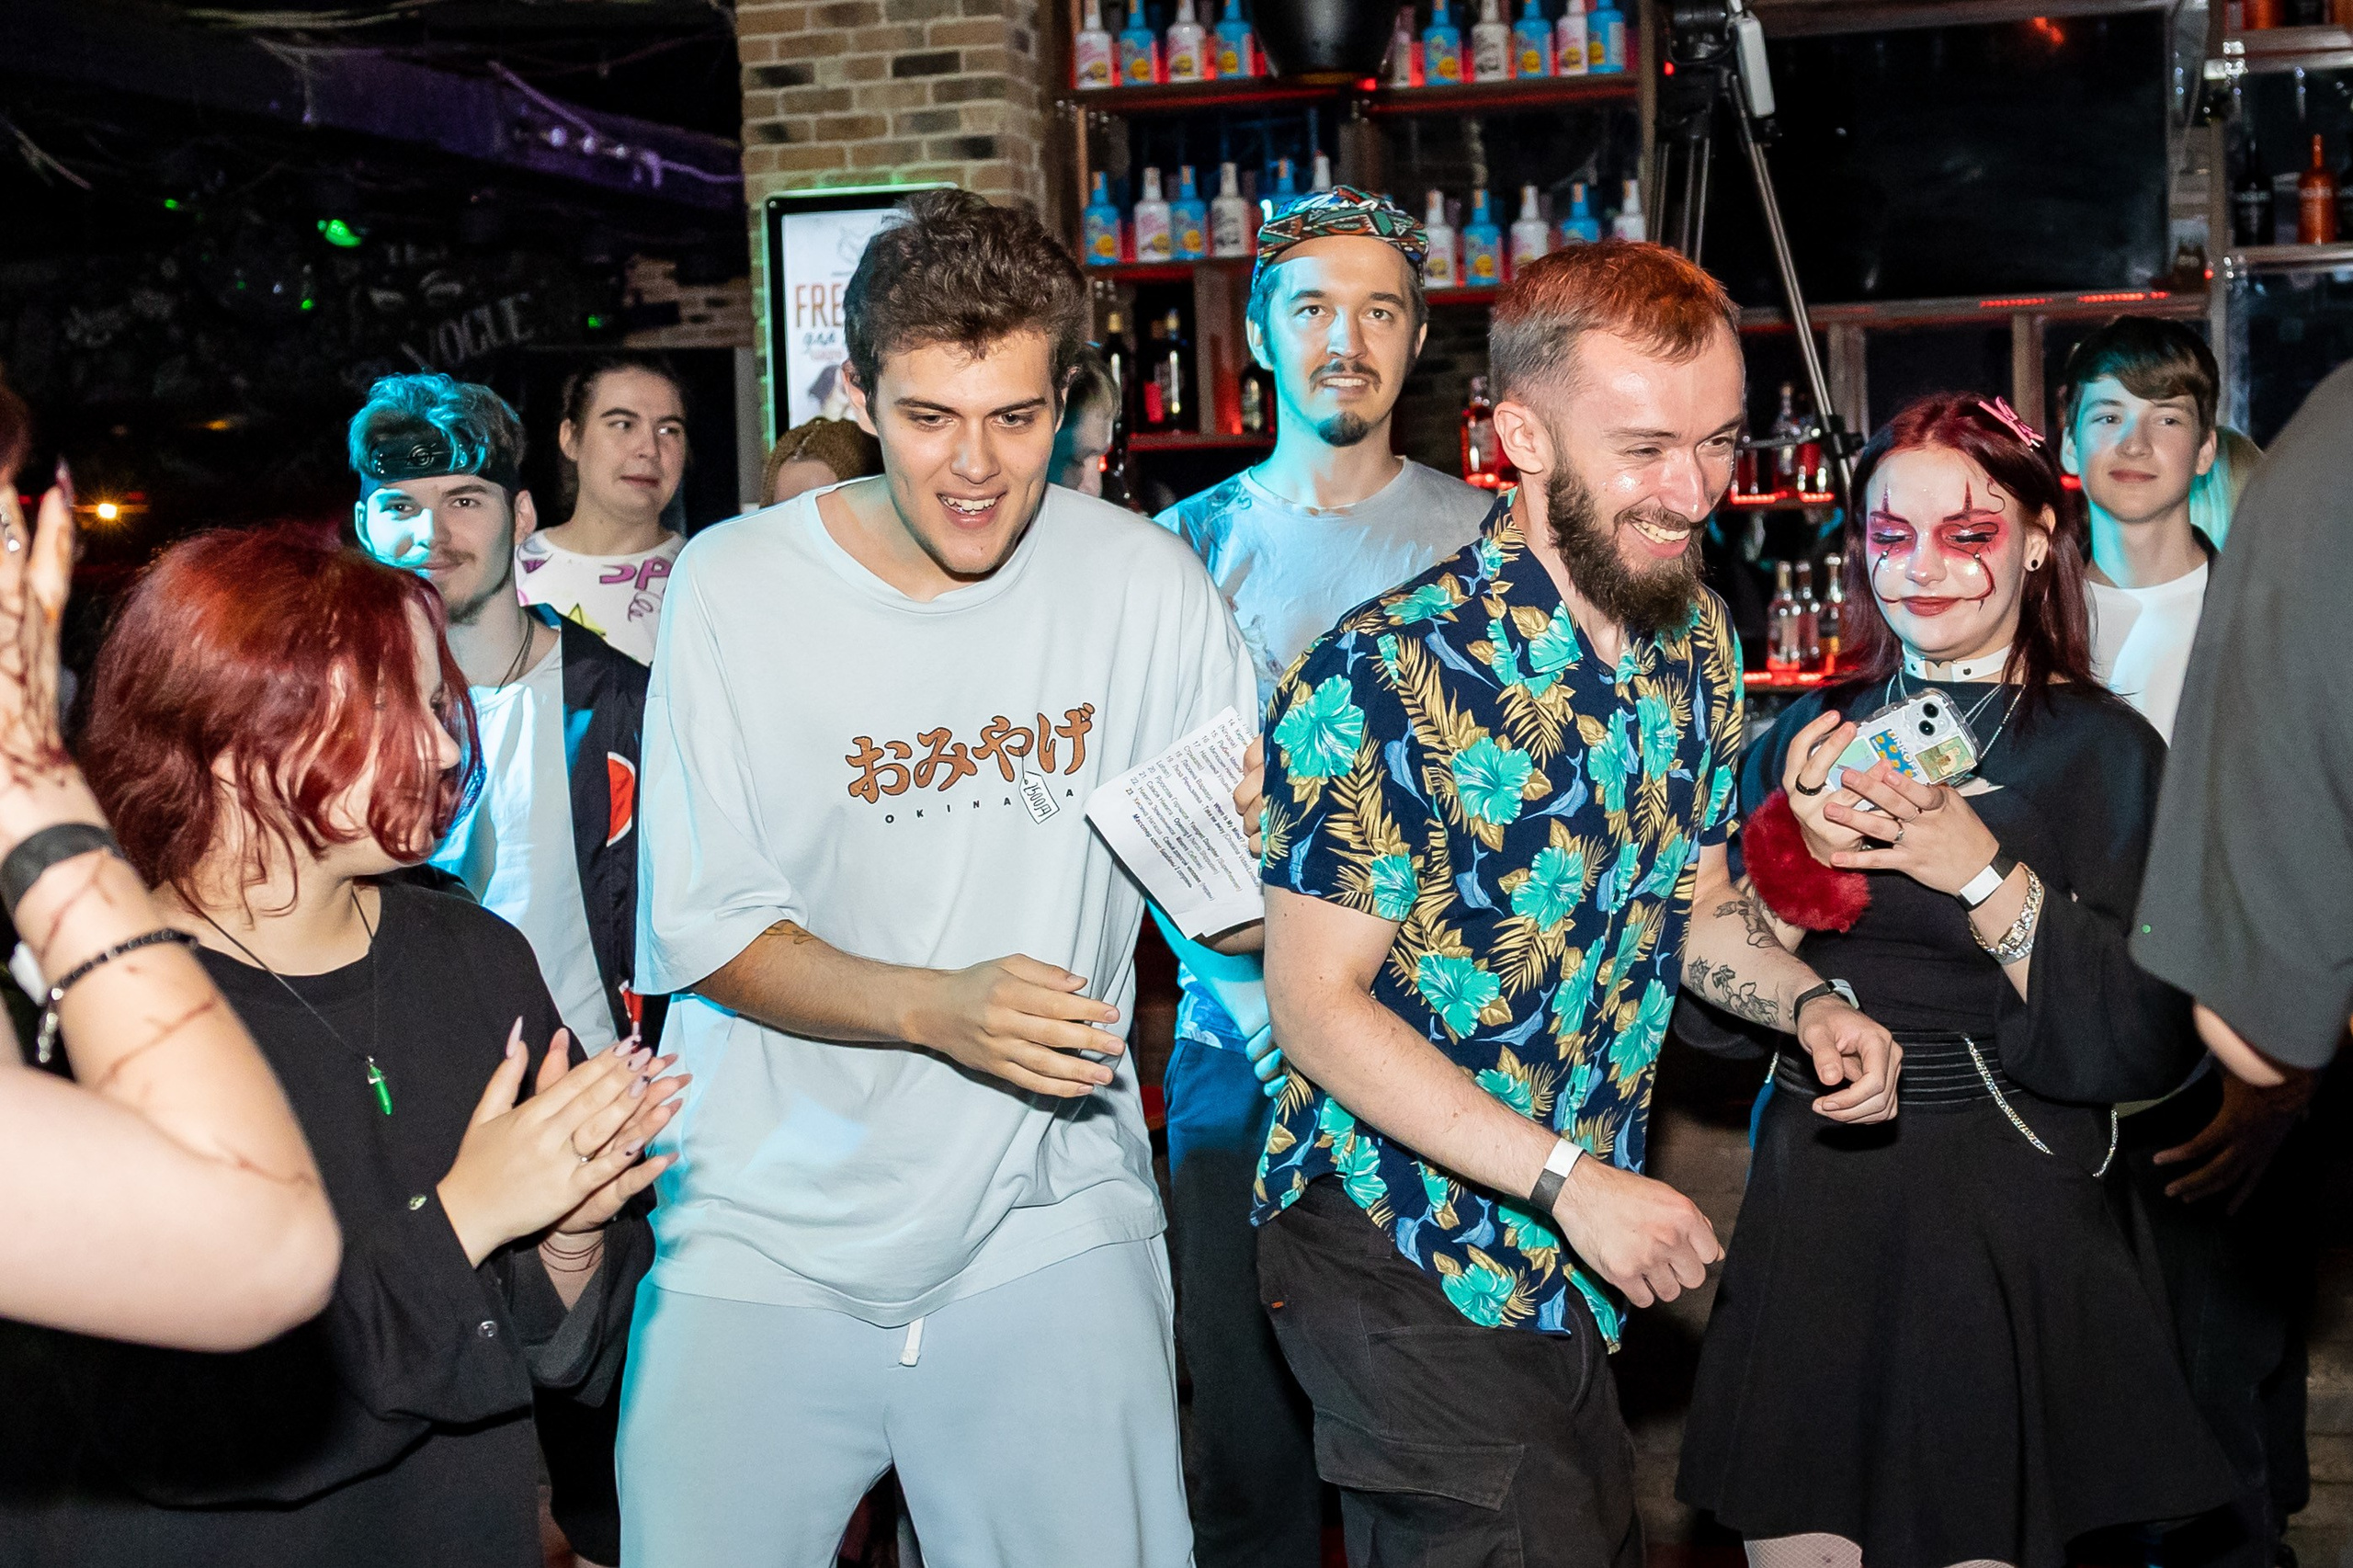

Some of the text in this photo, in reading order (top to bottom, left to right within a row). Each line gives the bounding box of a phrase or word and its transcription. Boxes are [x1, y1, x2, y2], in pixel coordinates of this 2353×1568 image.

[845, 701, 1096, 805] おみやげ
[884, 788, 1074, 824] OKINAA
